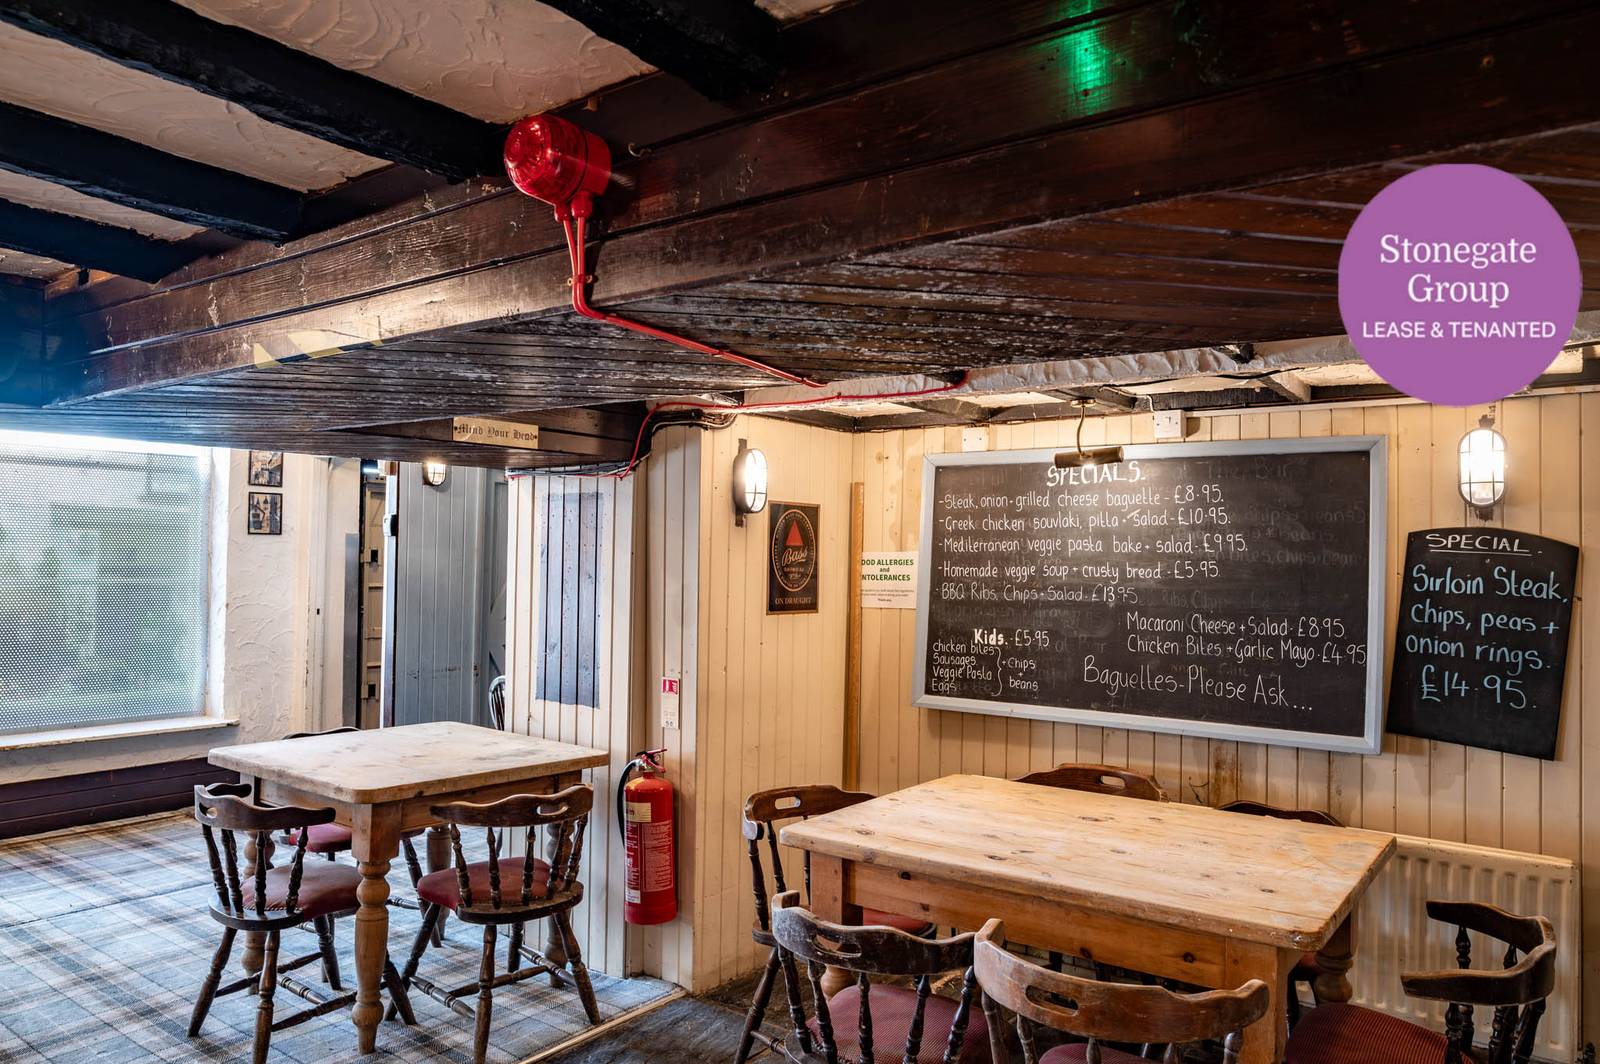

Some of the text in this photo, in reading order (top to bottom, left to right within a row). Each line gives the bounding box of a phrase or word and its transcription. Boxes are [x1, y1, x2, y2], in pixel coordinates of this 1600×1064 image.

[457, 423, 483, 435] Mind
[488, 426, 509, 437] Your
[1016, 491, 1050, 512] grilled
[1057, 490, 1099, 507] cheese
[1106, 487, 1160, 511] baguette
[982, 514, 1025, 531] chicken
[1089, 511, 1119, 532] pitta
[1133, 509, 1168, 527] salad
[1028, 538, 1061, 556] veggie
[1068, 536, 1103, 557] pasta
[1113, 535, 1141, 553] bake
[1156, 534, 1193, 554] salad
[1005, 564, 1036, 582] veggie
[1043, 565, 1069, 580] soup
[1082, 562, 1119, 584] crusty
[1127, 562, 1161, 579] bread
[1413, 563, 1568, 603] Sirloin Steak,
[1048, 585, 1083, 601] Salad
[1127, 611, 1184, 632] Macaroni
[1191, 613, 1236, 635] Cheese
[1248, 616, 1288, 636] Salad
[1480, 613, 1537, 636] peas
[1541, 622, 1560, 635] +
[970, 641, 995, 656] bites
[1015, 629, 1050, 647] £5.95
[932, 652, 977, 670] Sausages
[1127, 634, 1179, 655] Chicken
[1186, 635, 1222, 656] Bites
[1235, 638, 1274, 663] Garlic
[1281, 639, 1315, 668] Mayo
[932, 665, 992, 682] Veggie Pasta
[1009, 676, 1039, 691] beans
